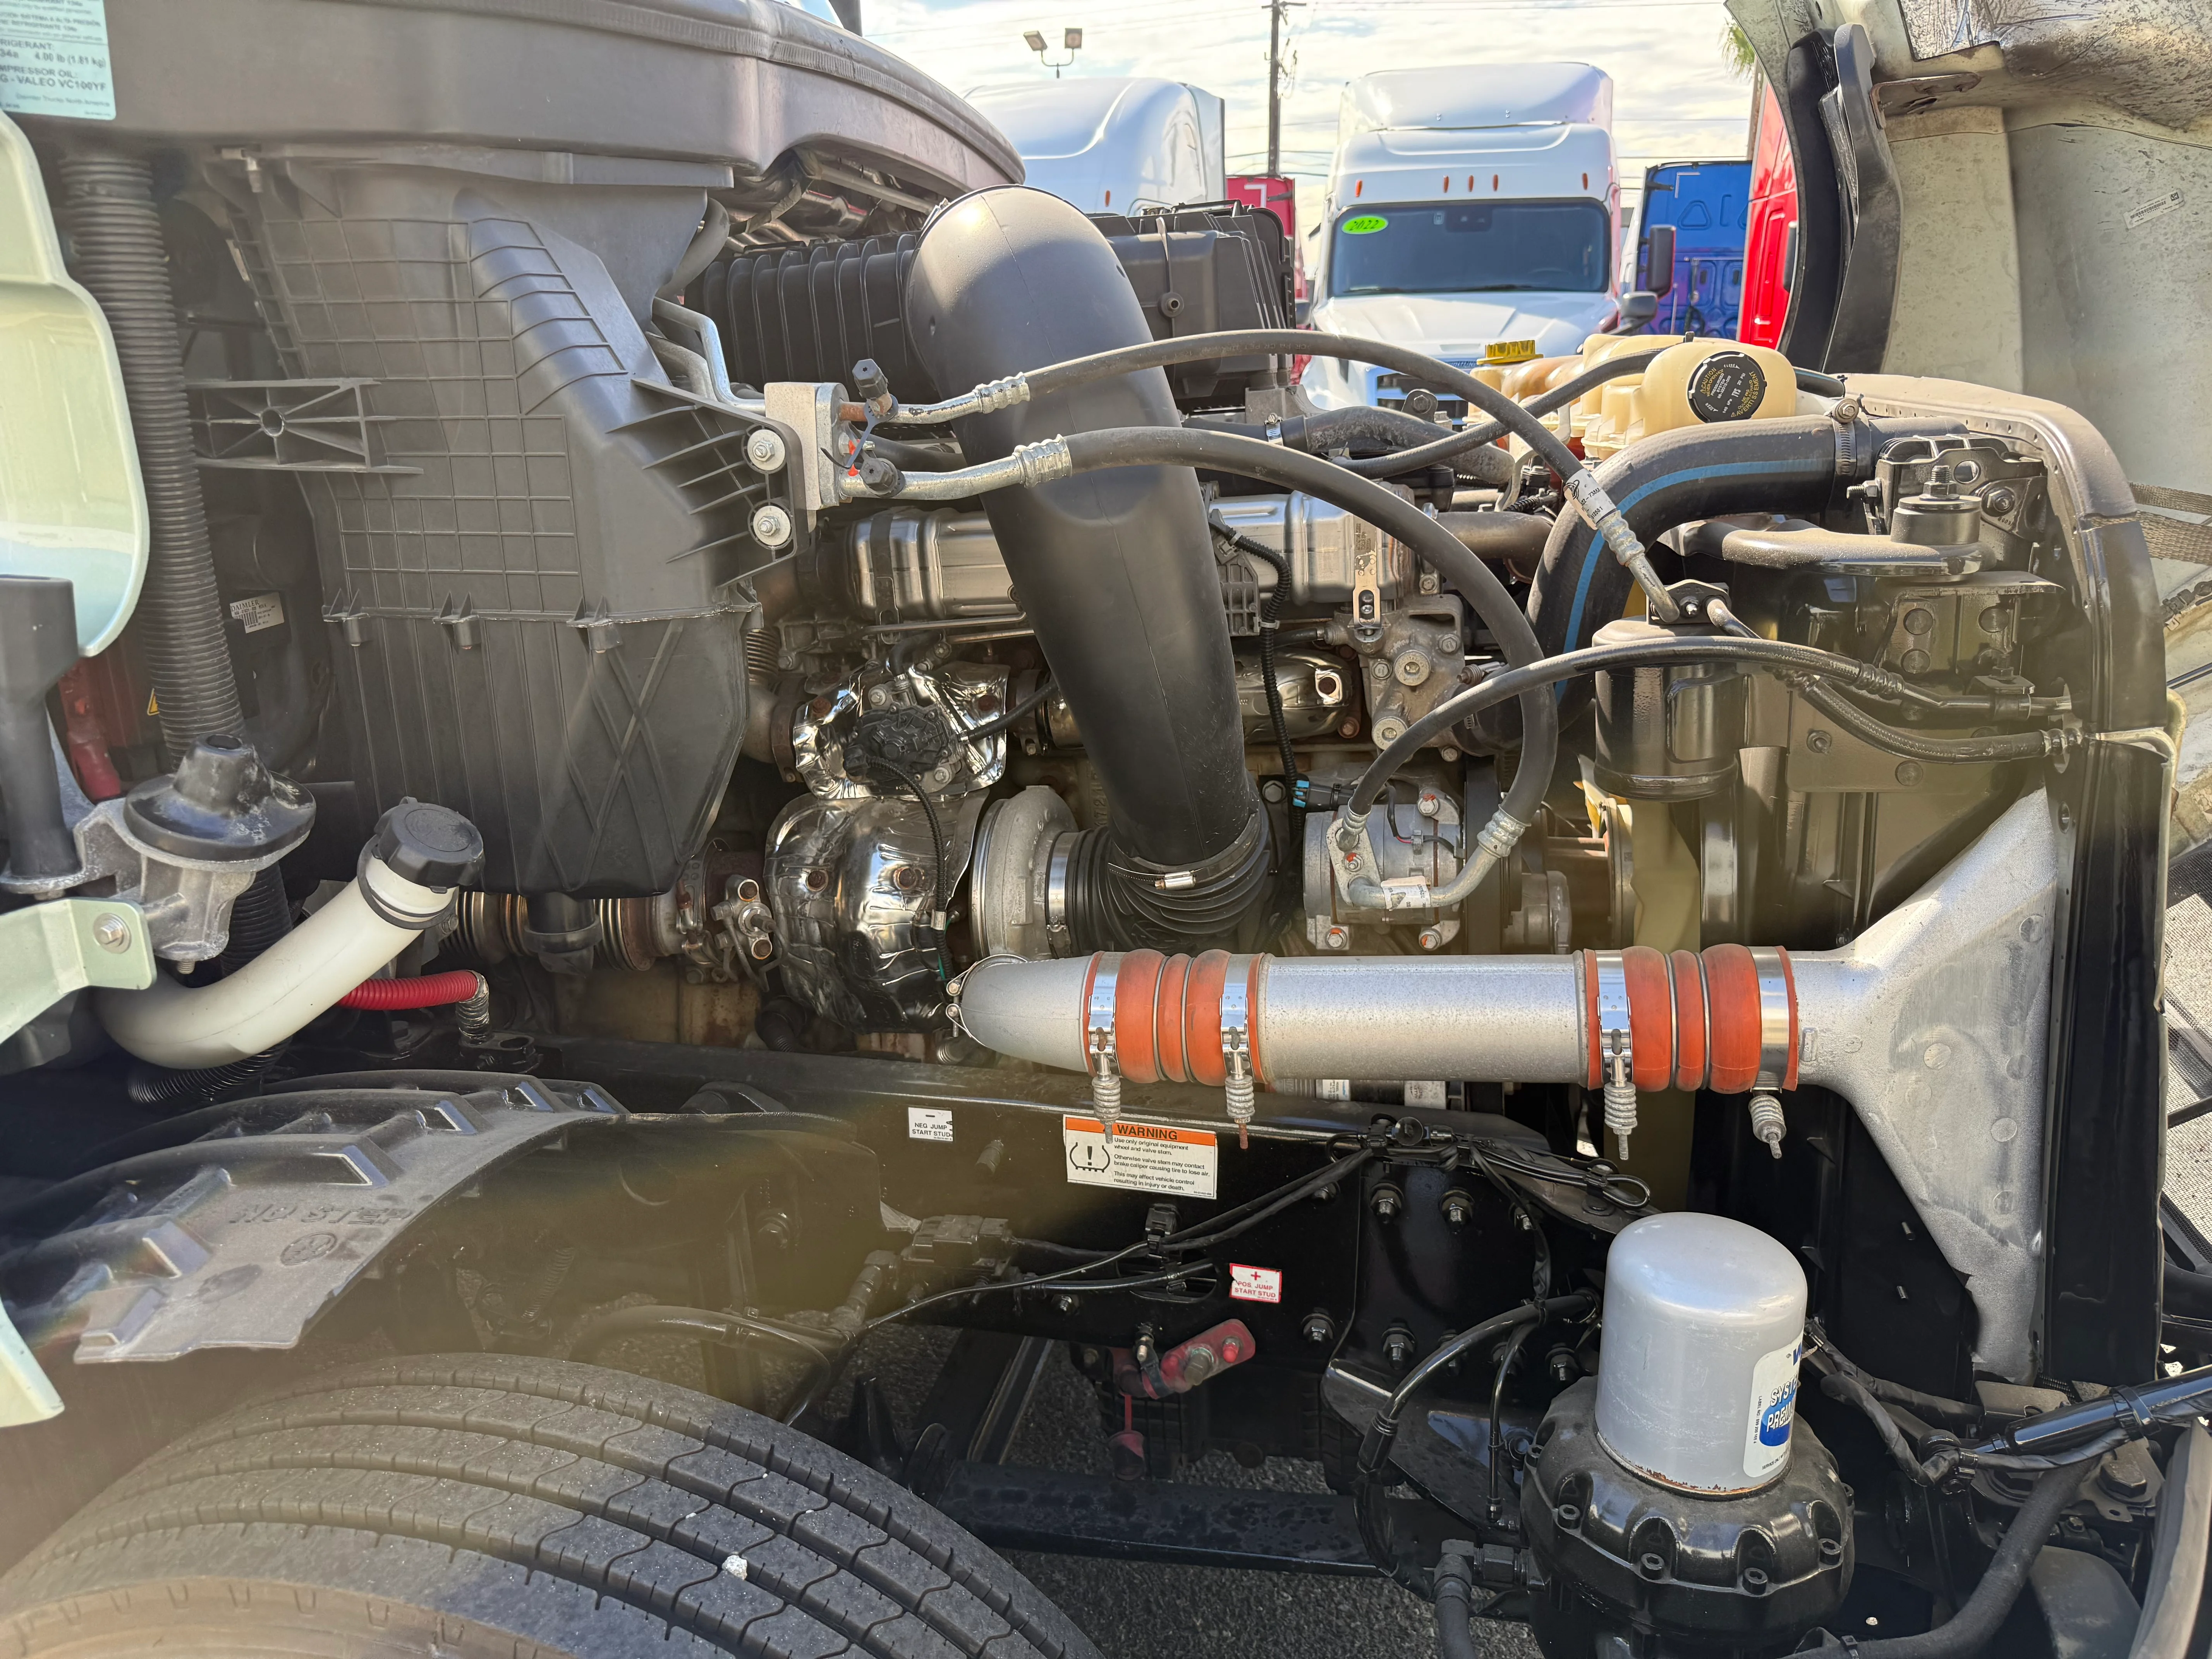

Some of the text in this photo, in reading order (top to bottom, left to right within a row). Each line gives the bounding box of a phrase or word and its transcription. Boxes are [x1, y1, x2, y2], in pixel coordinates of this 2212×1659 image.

[16, 75, 56, 87] VALEO
[58, 79, 106, 91] VC100YF
[1349, 220, 1379, 231] 2022
[1701, 368, 1717, 388] CAUTION
[1731, 388, 1741, 397] TVS
[1736, 371, 1759, 416] AVERTISSEMENT
[230, 599, 260, 612] DAIMLER
[1117, 1124, 1178, 1140] WARNING
[301, 1205, 414, 1225] STEP
